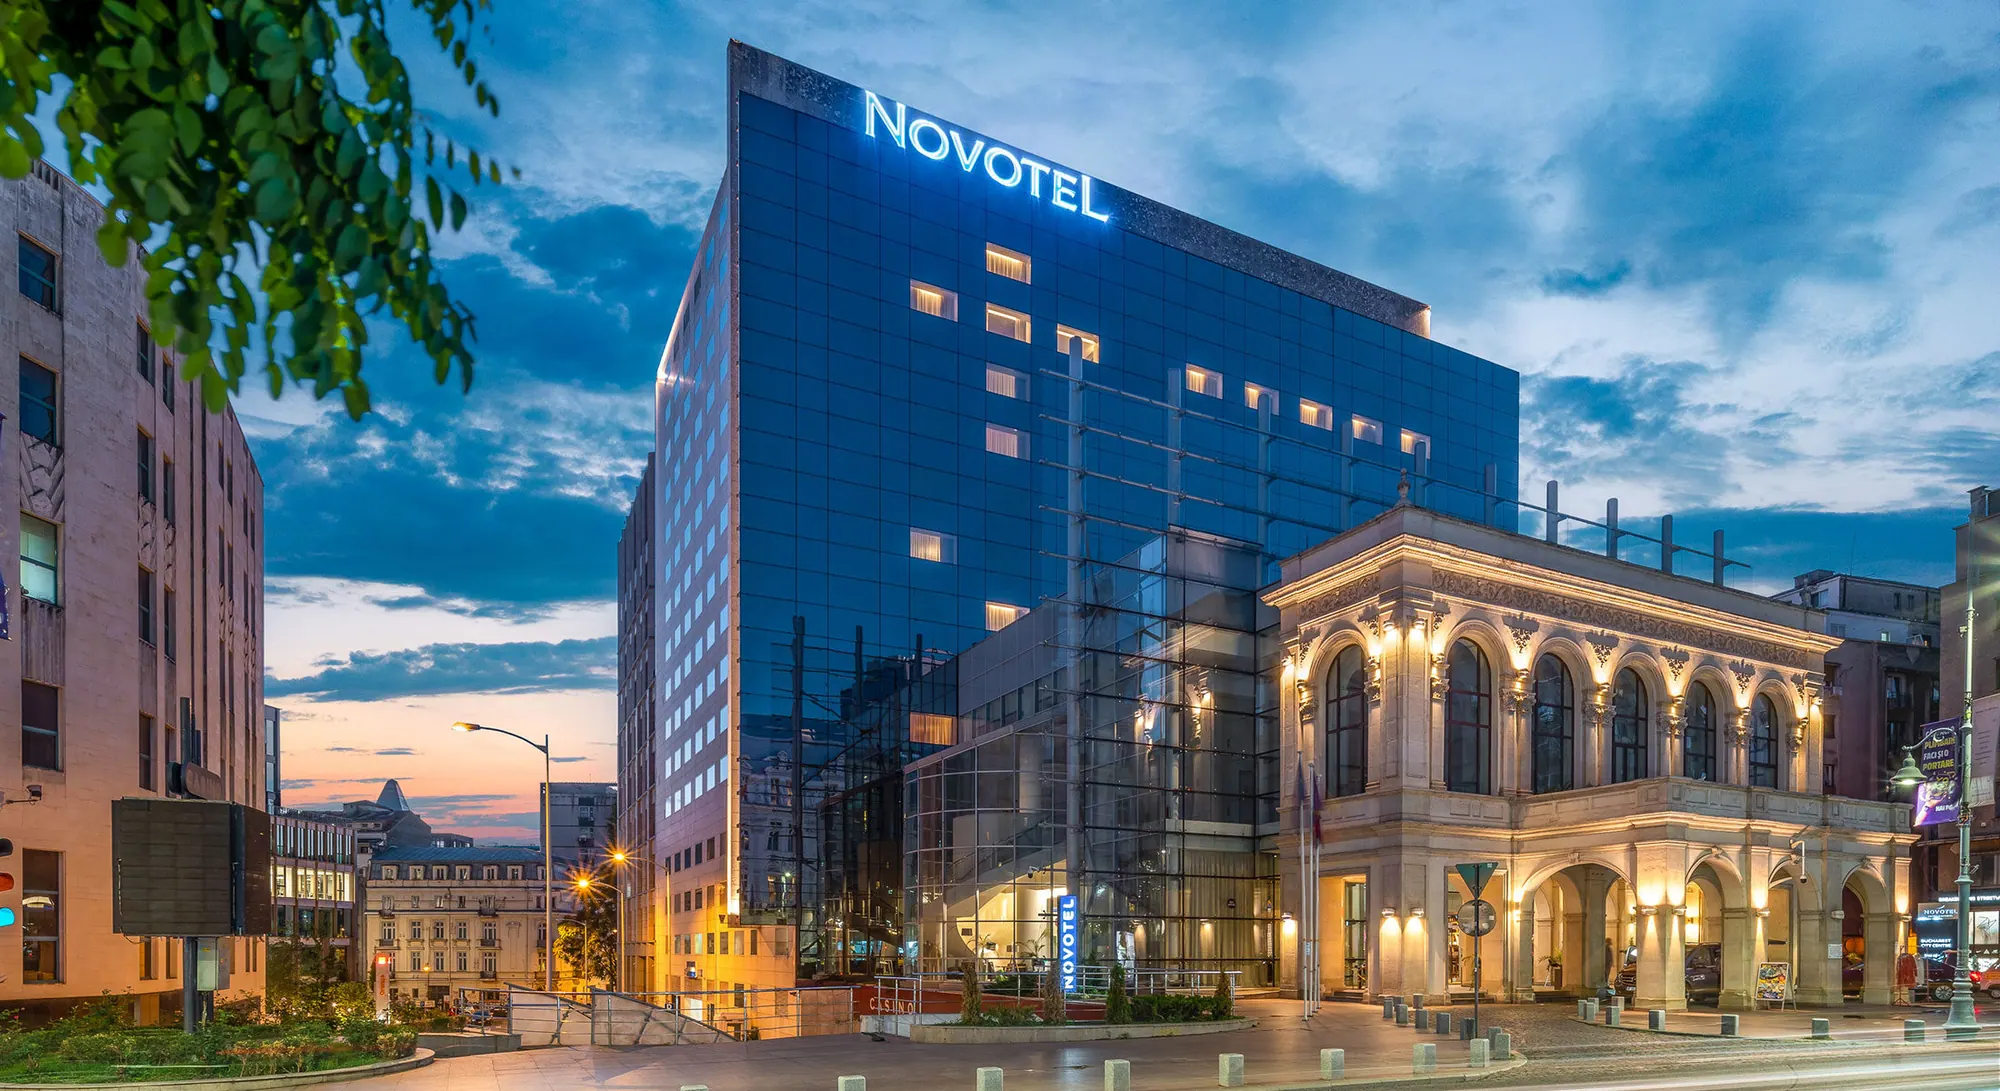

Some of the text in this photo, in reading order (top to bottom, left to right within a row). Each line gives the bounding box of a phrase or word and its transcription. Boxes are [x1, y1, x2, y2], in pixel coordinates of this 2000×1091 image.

[865, 90, 1109, 222] NOVOTEL
[1922, 758, 1955, 771] PORTARE
[1923, 751, 1937, 760] FACI
[1063, 898, 1075, 989] NOVOTEL
